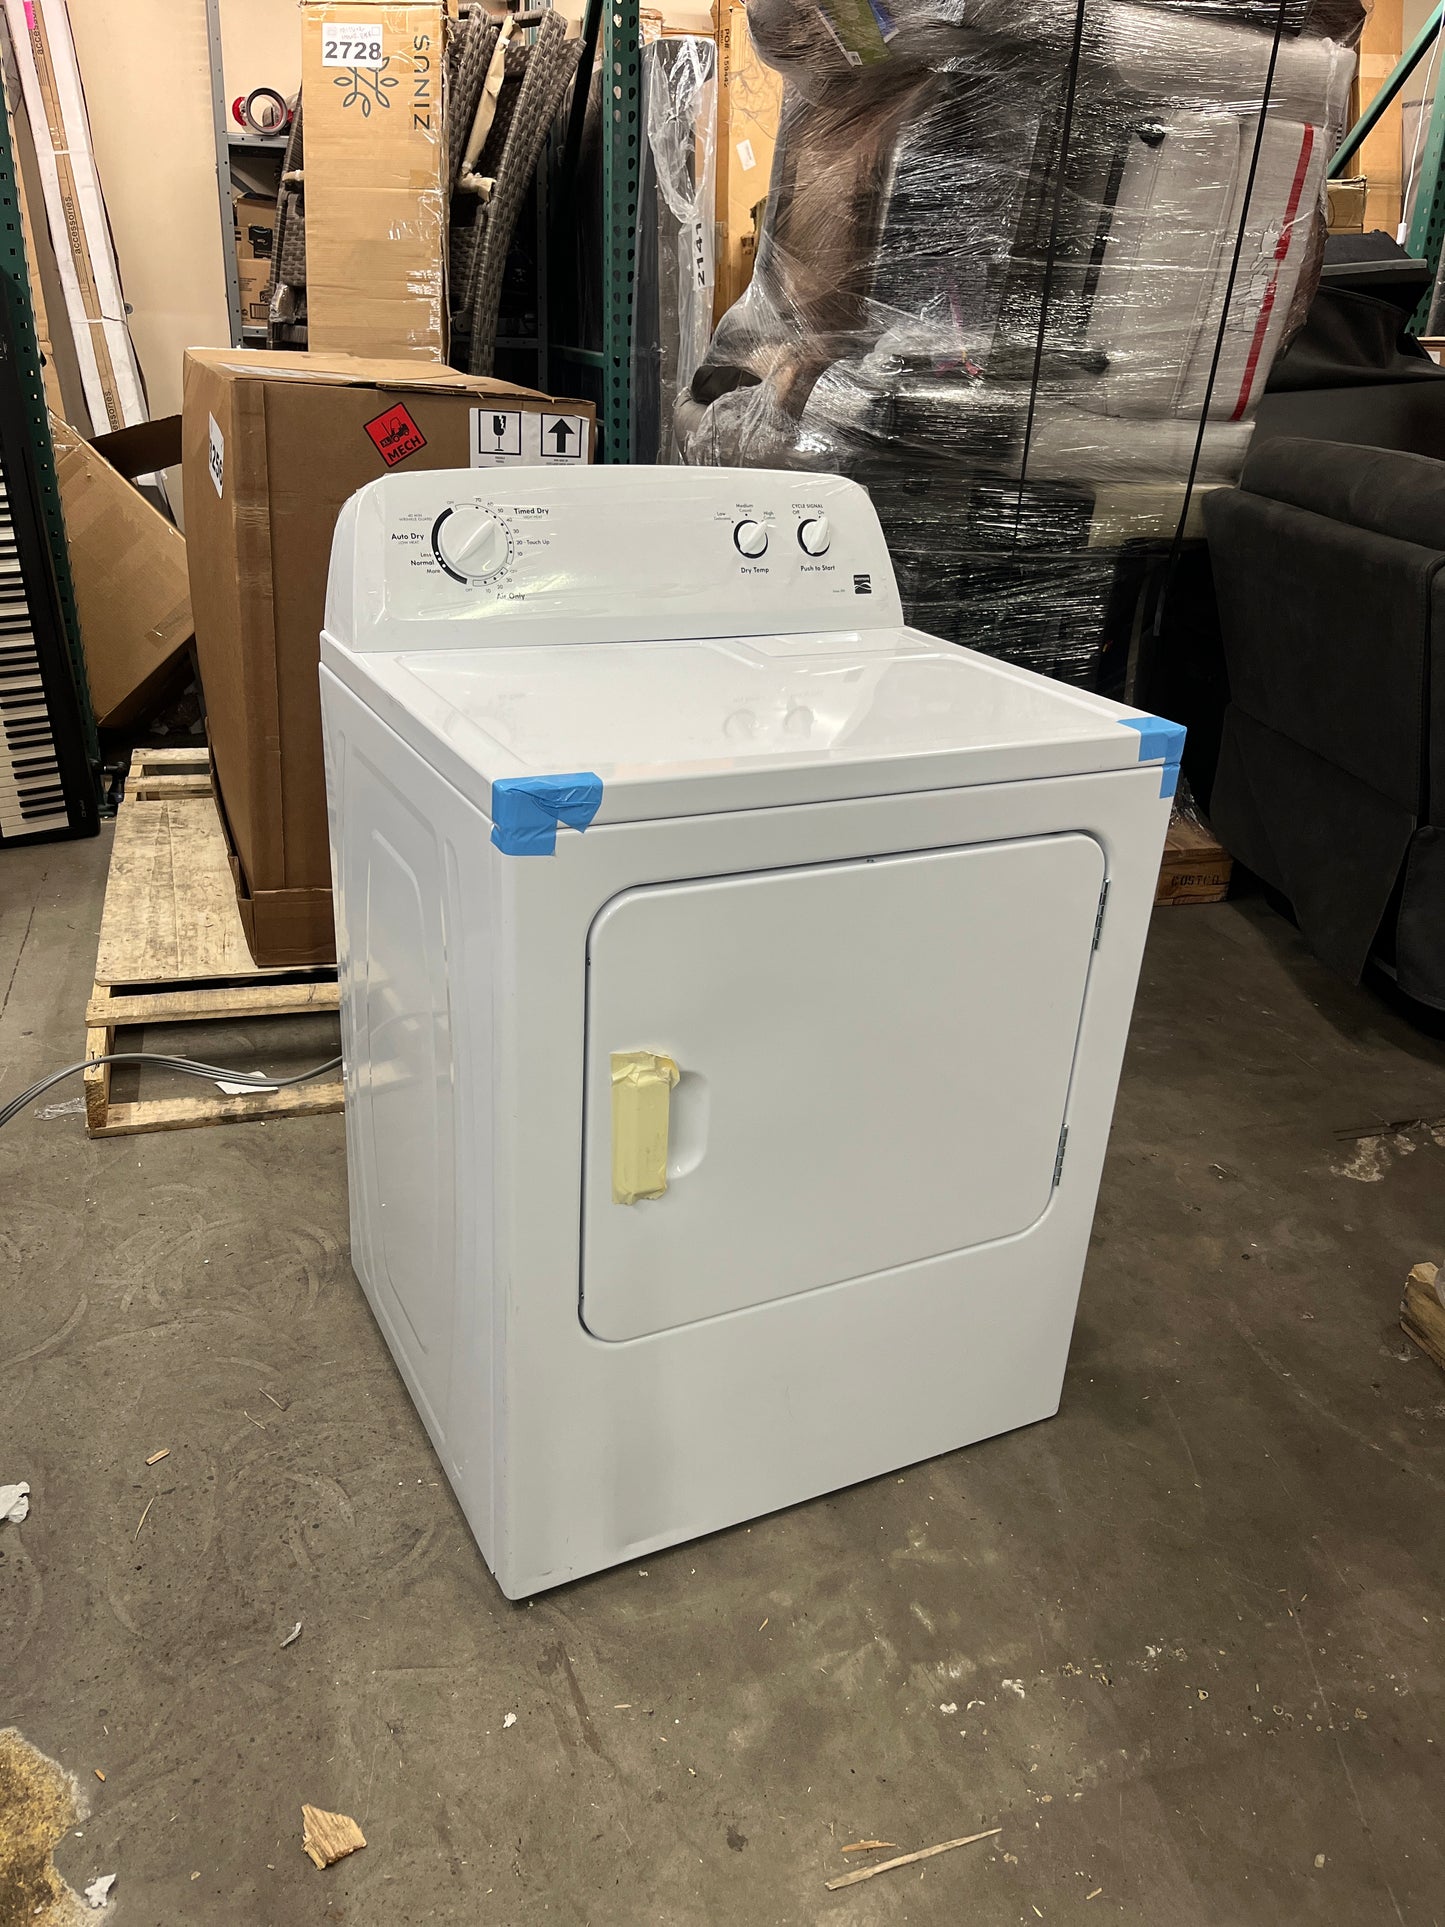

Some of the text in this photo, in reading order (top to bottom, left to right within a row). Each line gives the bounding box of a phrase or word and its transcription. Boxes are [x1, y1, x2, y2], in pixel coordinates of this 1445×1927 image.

[325, 41, 381, 60] 2728
[414, 34, 430, 130] ZINUS
[65, 194, 81, 255] accessories
[104, 389, 119, 430] essories
[387, 435, 421, 461] MECH
[537, 507, 549, 515] Dry
